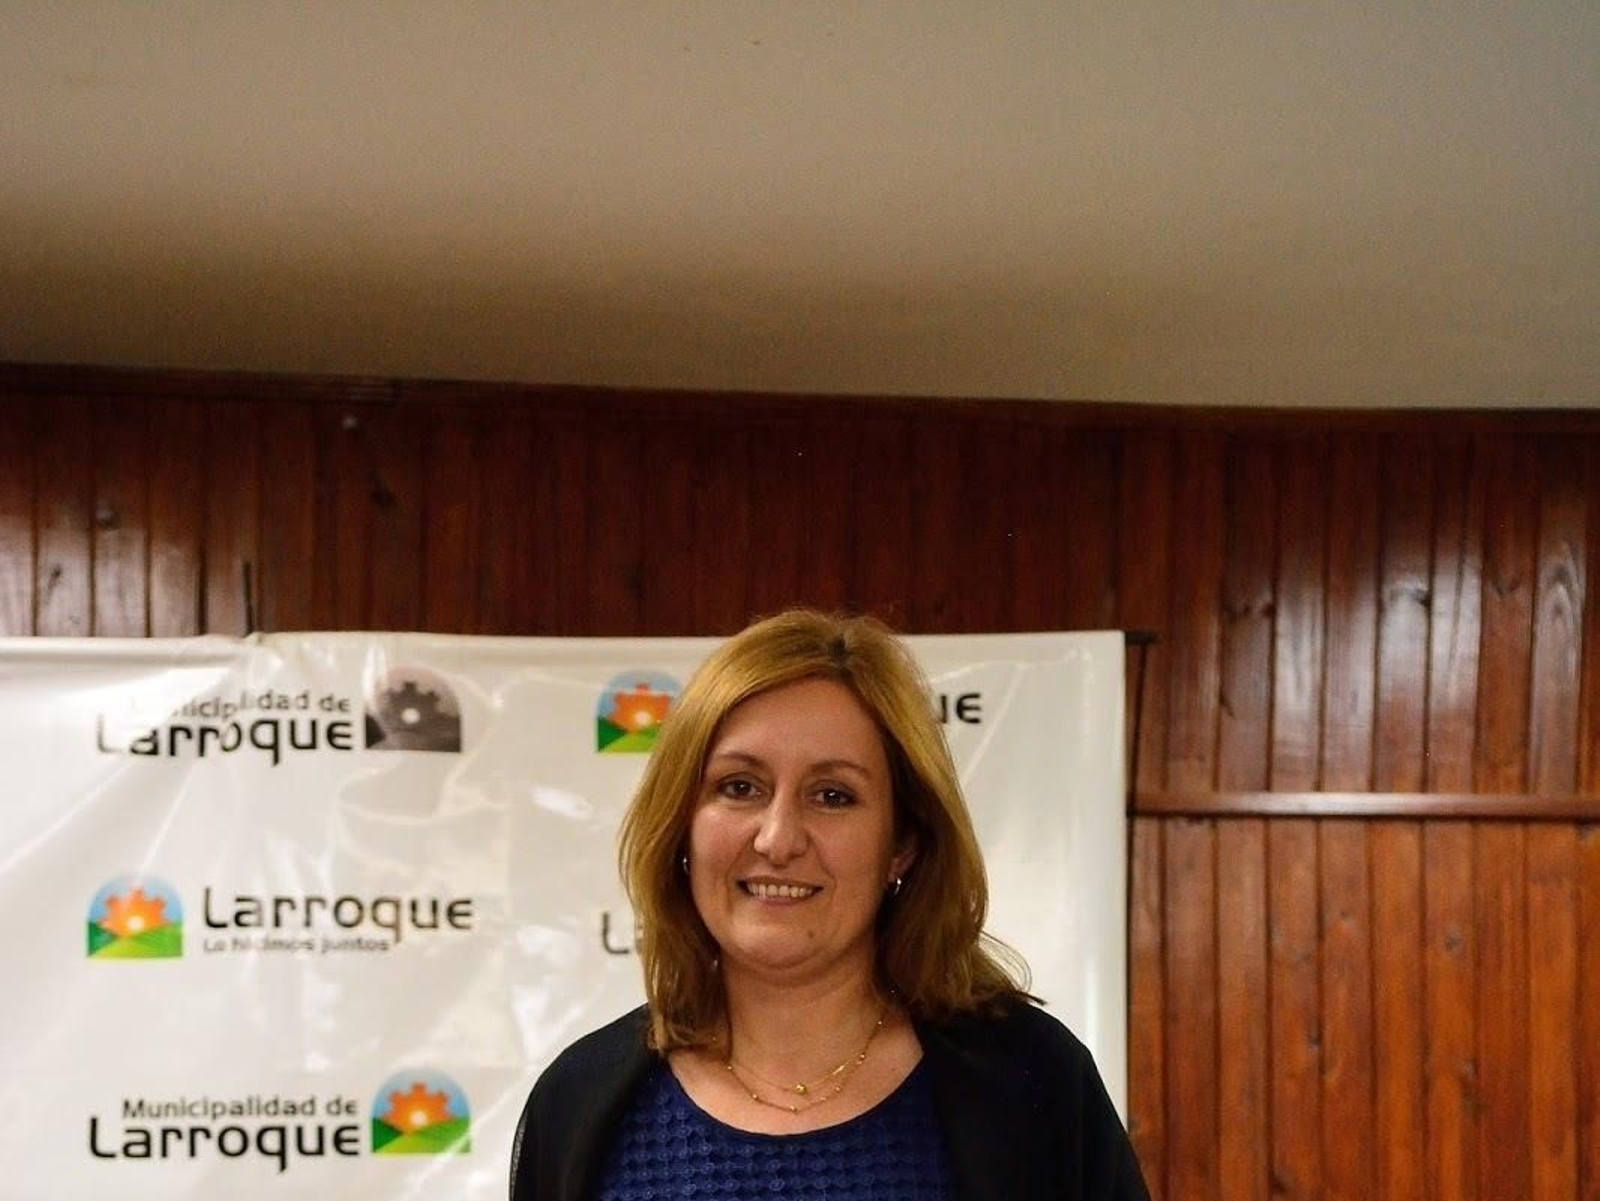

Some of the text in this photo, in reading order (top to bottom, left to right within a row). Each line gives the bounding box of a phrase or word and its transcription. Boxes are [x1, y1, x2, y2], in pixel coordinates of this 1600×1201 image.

[318, 694, 350, 712] de
[97, 713, 353, 767] Larroque
[204, 886, 475, 944] Larroque
[232, 935, 314, 951] hiimos
[122, 1094, 358, 1120] Municipalidad de
[90, 1116, 360, 1174] Larroque
